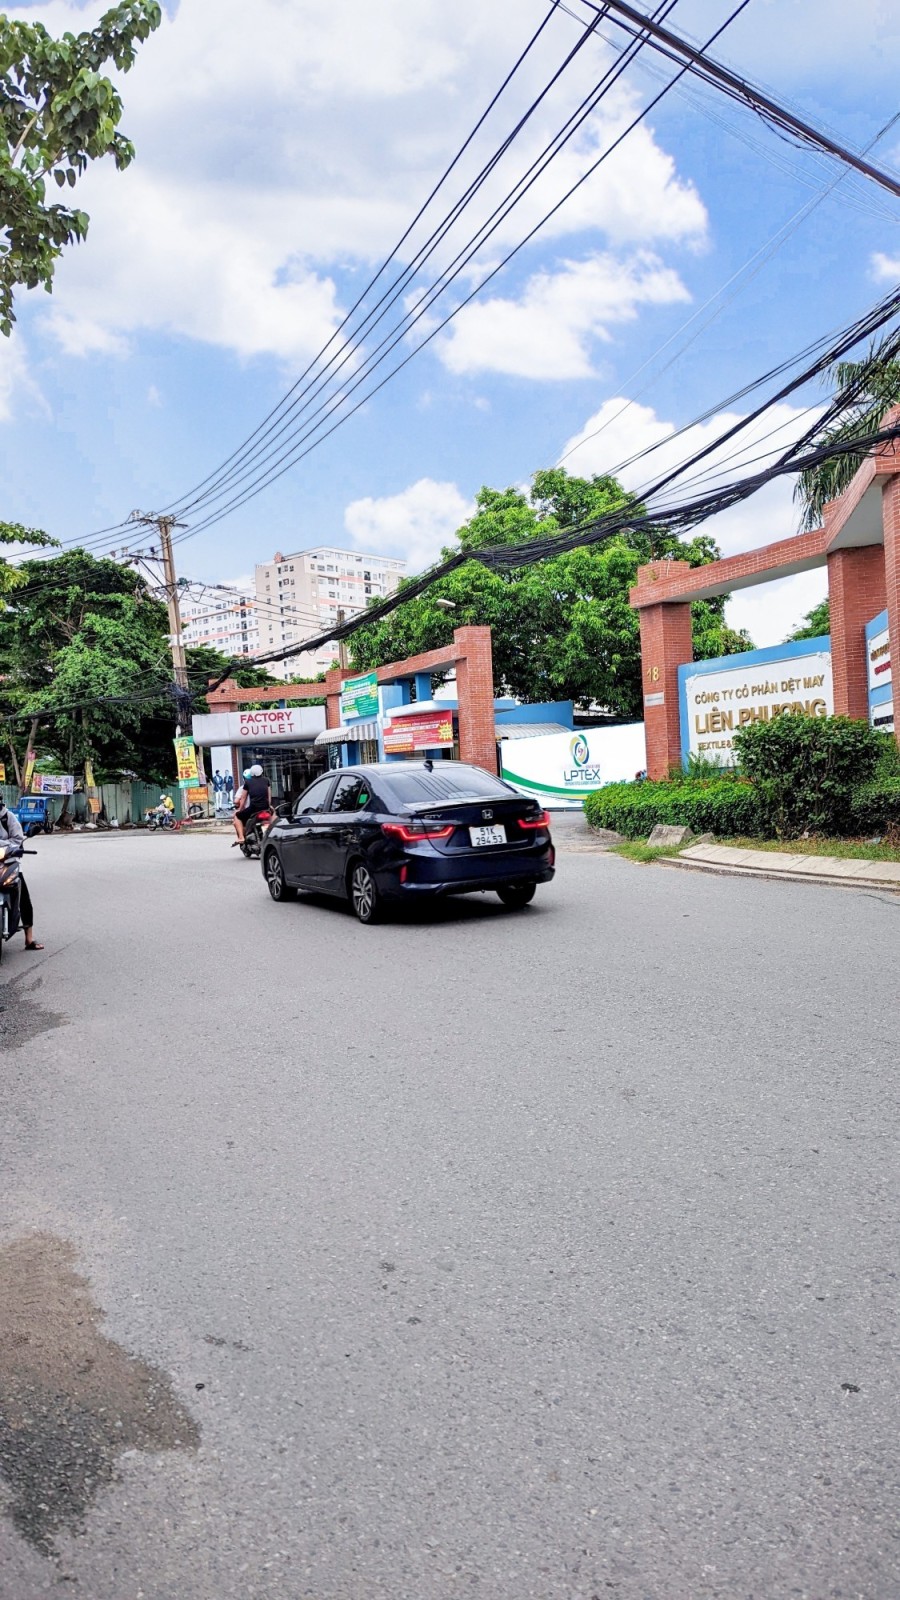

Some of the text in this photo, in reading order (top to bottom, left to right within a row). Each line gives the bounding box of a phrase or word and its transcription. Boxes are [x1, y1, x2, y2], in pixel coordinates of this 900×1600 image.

[646, 666, 660, 682] 18
[695, 691, 720, 705] CÔNG
[722, 689, 734, 701] TY
[781, 677, 801, 694] DỆT
[803, 674, 825, 689] MAY
[240, 711, 292, 724] FACTORY
[695, 706, 733, 734] LIÊN
[240, 723, 295, 736] OUTLET
[563, 768, 601, 782] LPTEX
[479, 827, 496, 836] 51K
[475, 835, 503, 846] 294.53
